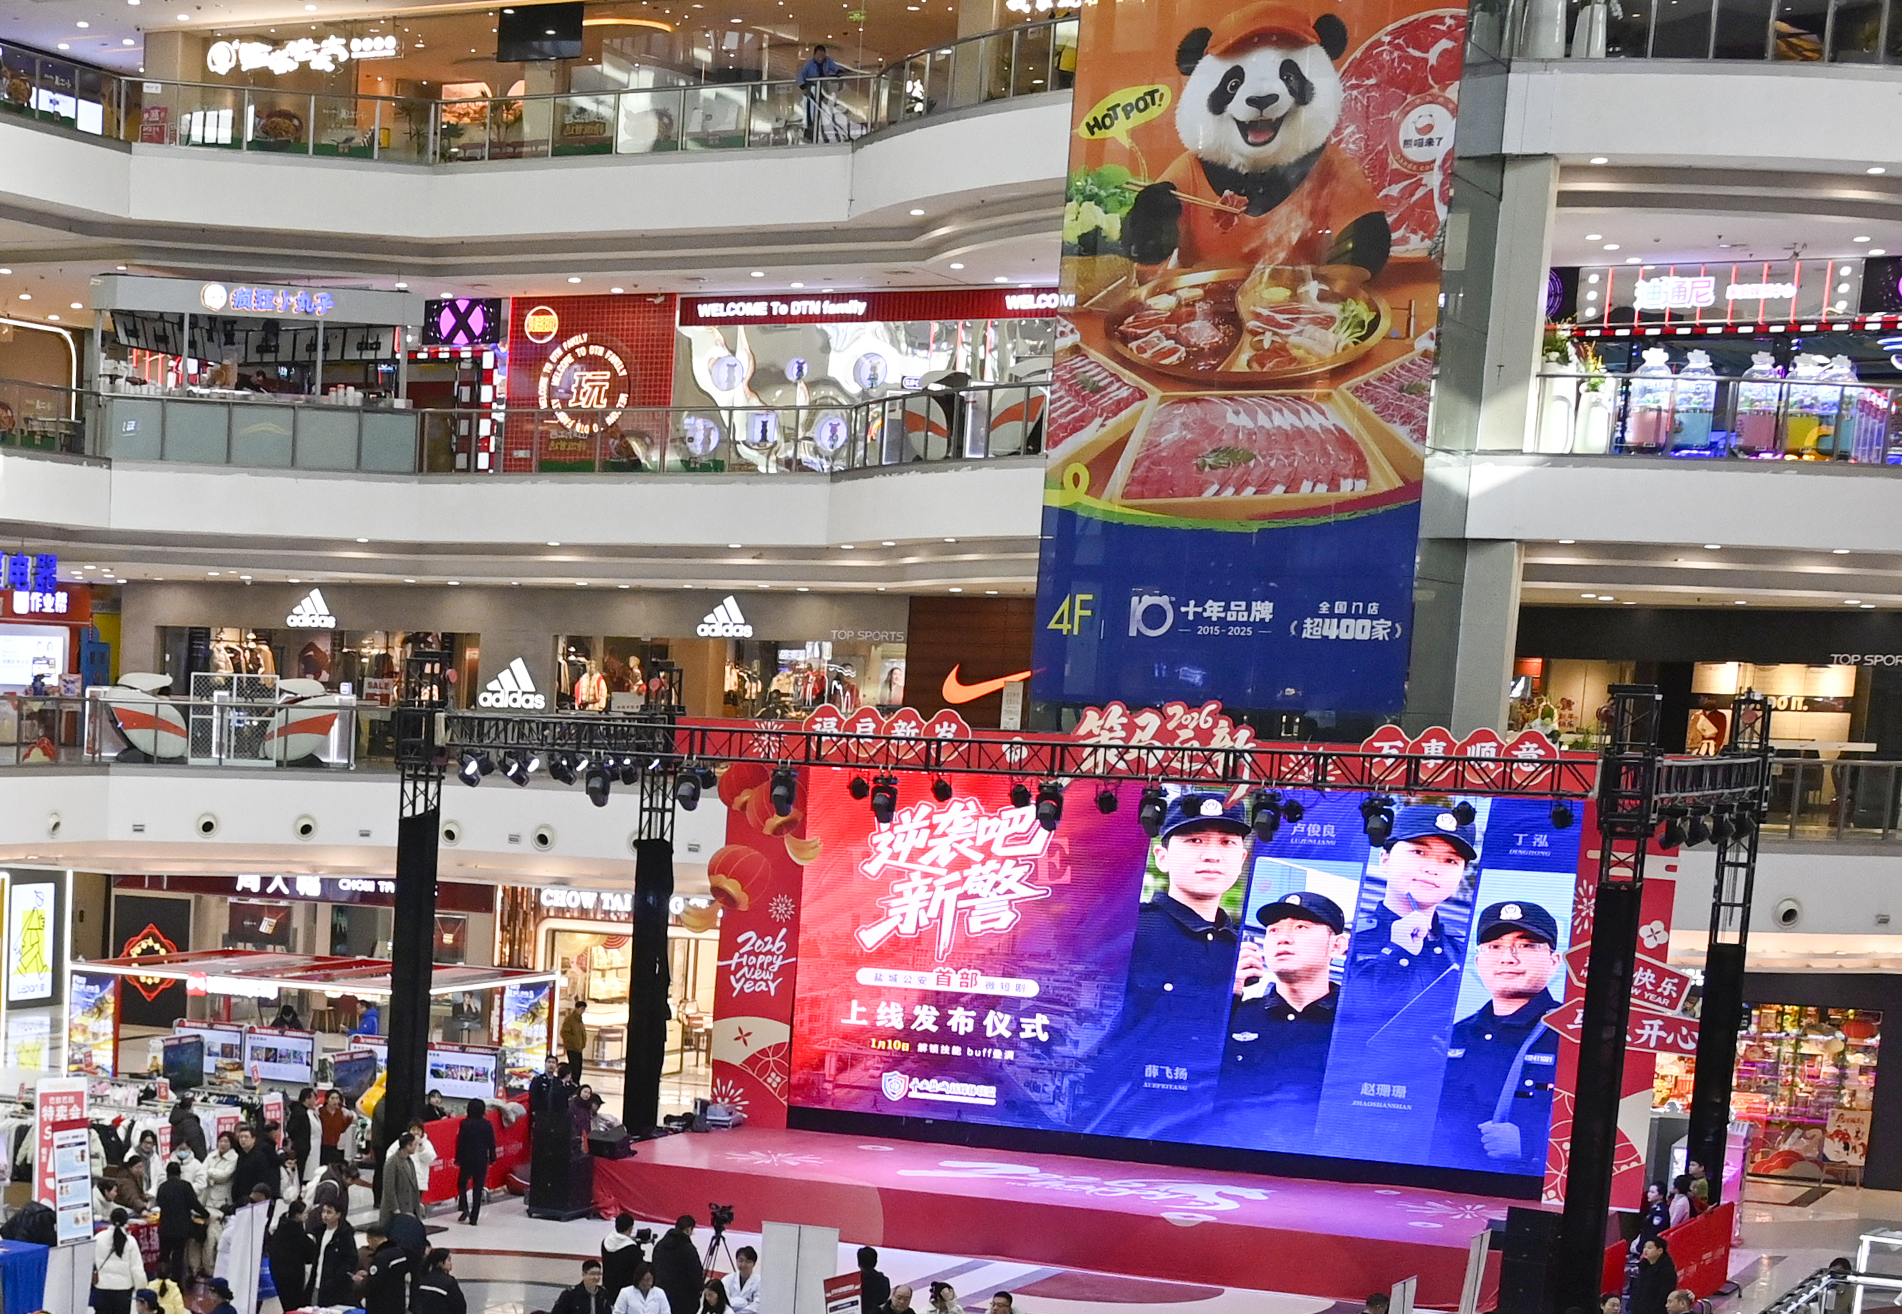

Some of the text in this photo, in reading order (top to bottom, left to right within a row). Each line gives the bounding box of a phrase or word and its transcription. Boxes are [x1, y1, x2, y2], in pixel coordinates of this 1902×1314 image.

[1085, 104, 1122, 137] HOT
[1402, 136, 1444, 149] 熊喵来了
[231, 287, 334, 316] 疯狂小丸子
[1636, 277, 1715, 309] 迪通尼
[697, 298, 867, 318] WELCOME To DTN family
[569, 371, 611, 409] 玩
[29, 591, 69, 614] 作业帮
[1179, 598, 1274, 624] 十年品牌
[1318, 601, 1380, 614] 全国门店
[286, 612, 336, 629] adidas
[1047, 593, 1093, 636] 4F
[696, 622, 753, 639] adidas
[830, 629, 905, 642] TOP SPORTS
[1197, 625, 1253, 638] 2015-2025
[1301, 617, 1391, 641] 超400家
[366, 680, 390, 690] SALE
[478, 689, 546, 710] adidas
[1166, 703, 1214, 729] 2026
[1372, 738, 1545, 774] 万事顺意
[863, 800, 1051, 877] 逆袭吧
[1290, 822, 1337, 839] 卢俊良
[378, 880, 396, 894] TA
[540, 888, 633, 912] CHOW TAI
[857, 859, 1051, 960] 新警
[737, 927, 787, 954] 2026
[742, 967, 774, 982] New
[731, 977, 782, 997] Year
[1644, 990, 1670, 1007] YEAR
[841, 999, 1050, 1042] 上线发布仪式
[870, 1037, 910, 1052] 1月10日
[1635, 1019, 1699, 1049] 开心
[1360, 1081, 1407, 1099] 赵珊珊
[40, 1105, 82, 1120] 特卖会
